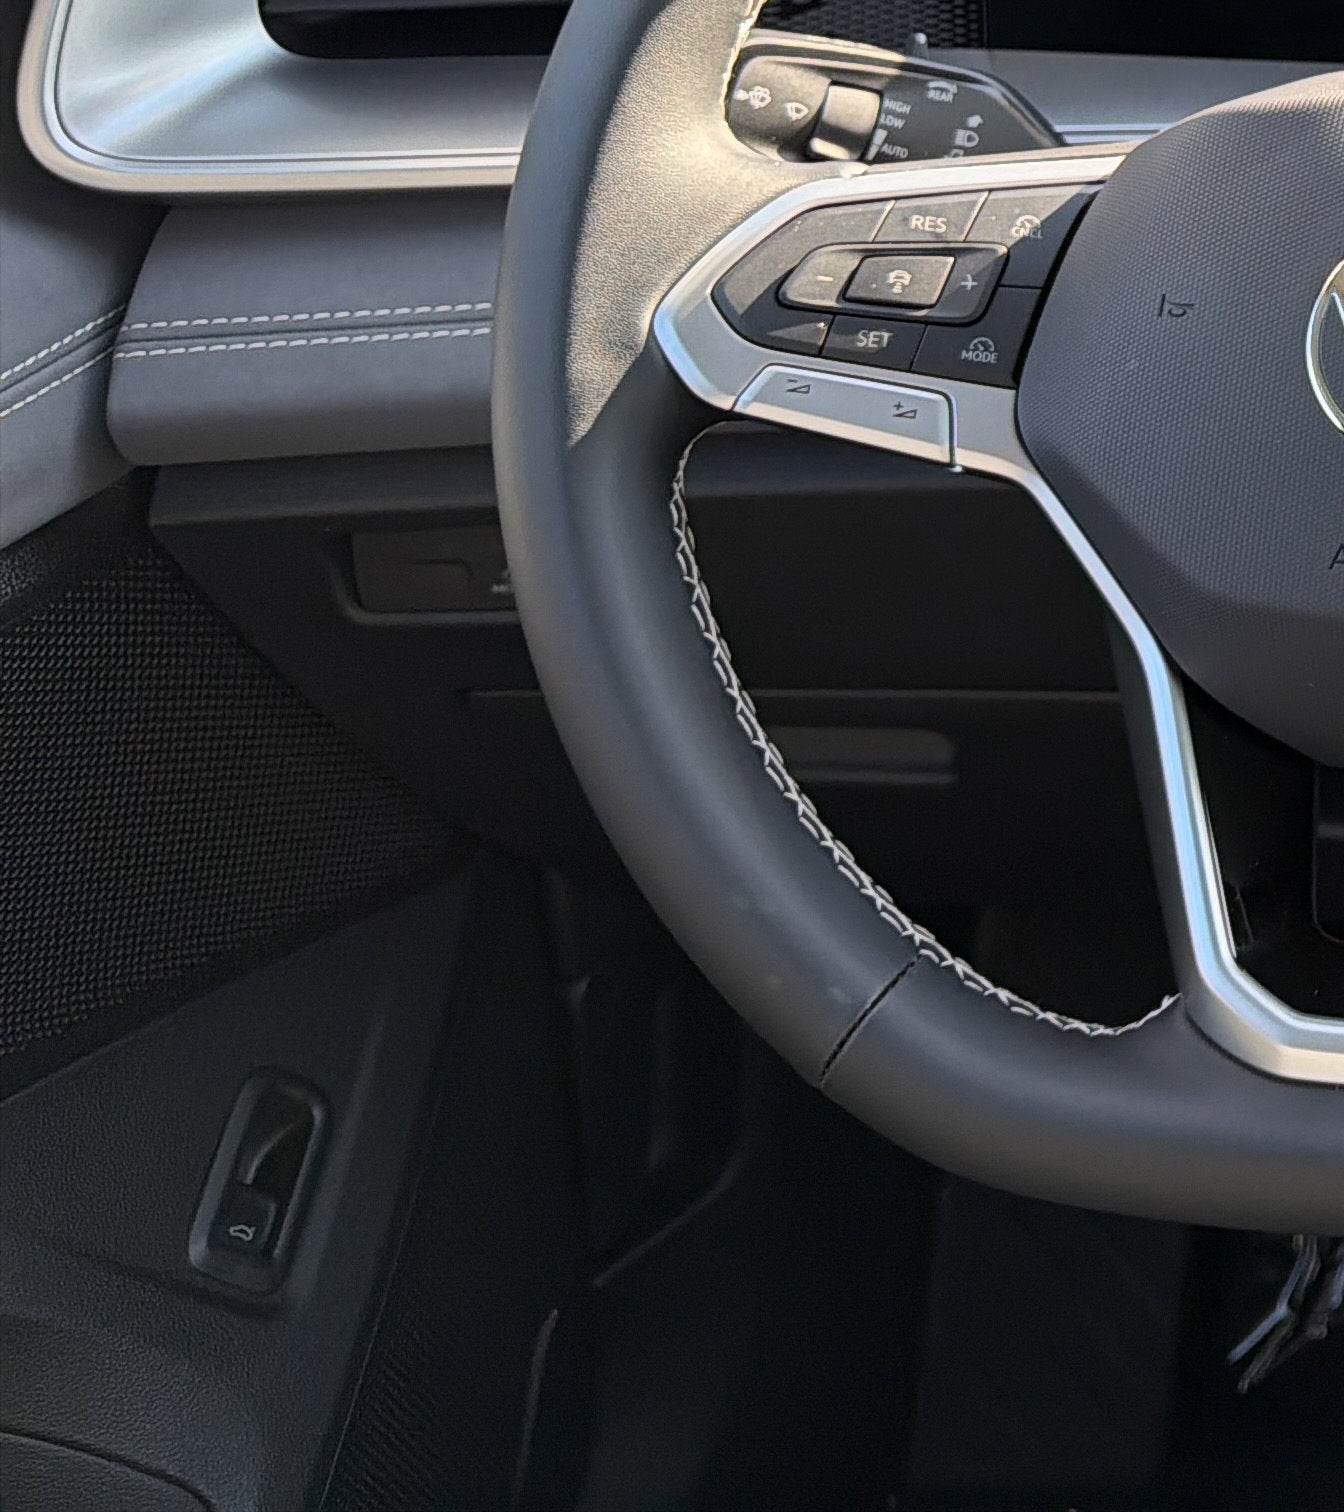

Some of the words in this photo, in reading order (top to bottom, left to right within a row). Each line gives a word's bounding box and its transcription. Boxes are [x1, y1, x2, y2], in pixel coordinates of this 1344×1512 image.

[928, 88, 954, 103] REAR
[882, 98, 911, 115] HIGH
[880, 113, 906, 129] LOW
[881, 143, 909, 159] AUTO
[911, 214, 948, 234] RES
[856, 330, 893, 349] SET
[961, 347, 998, 365] MODE
